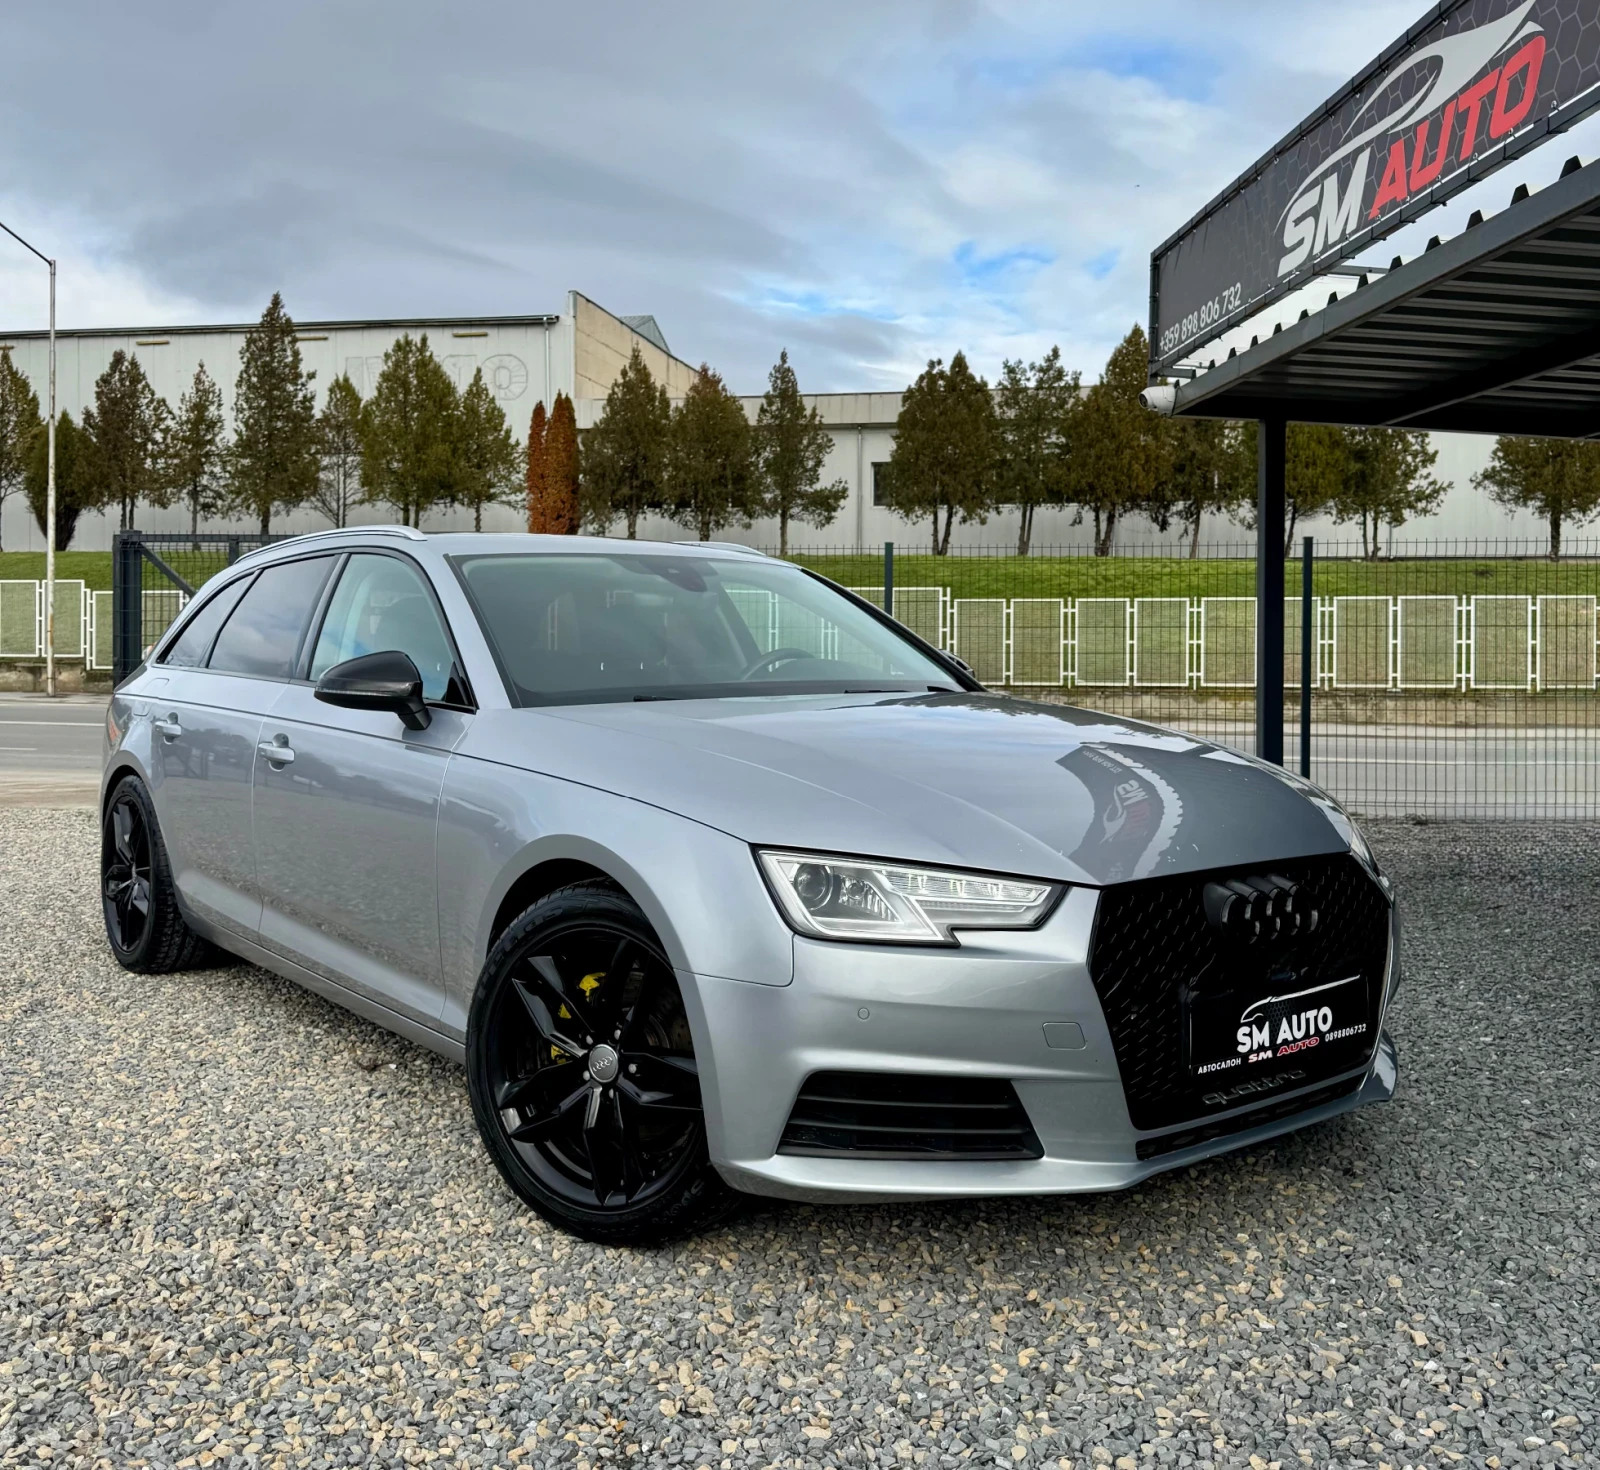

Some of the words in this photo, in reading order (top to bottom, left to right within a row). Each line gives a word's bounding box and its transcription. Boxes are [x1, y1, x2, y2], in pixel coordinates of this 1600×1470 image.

[1277, 147, 1371, 278] SM
[1368, 35, 1546, 221] AUTO
[1160, 323, 1180, 352] +359
[1181, 311, 1198, 342] 898
[1200, 296, 1220, 328] 806
[1222, 282, 1241, 315] 732
[1236, 1021, 1270, 1053] SM
[1276, 1006, 1333, 1044] AUTO
[1325, 1023, 1367, 1042] 0898806732
[1197, 1057, 1242, 1075] АВТОСАЛОН
[1248, 1050, 1273, 1063] SM
[1277, 1036, 1320, 1056] AUTO
[1202, 1069, 1306, 1105] quattro
